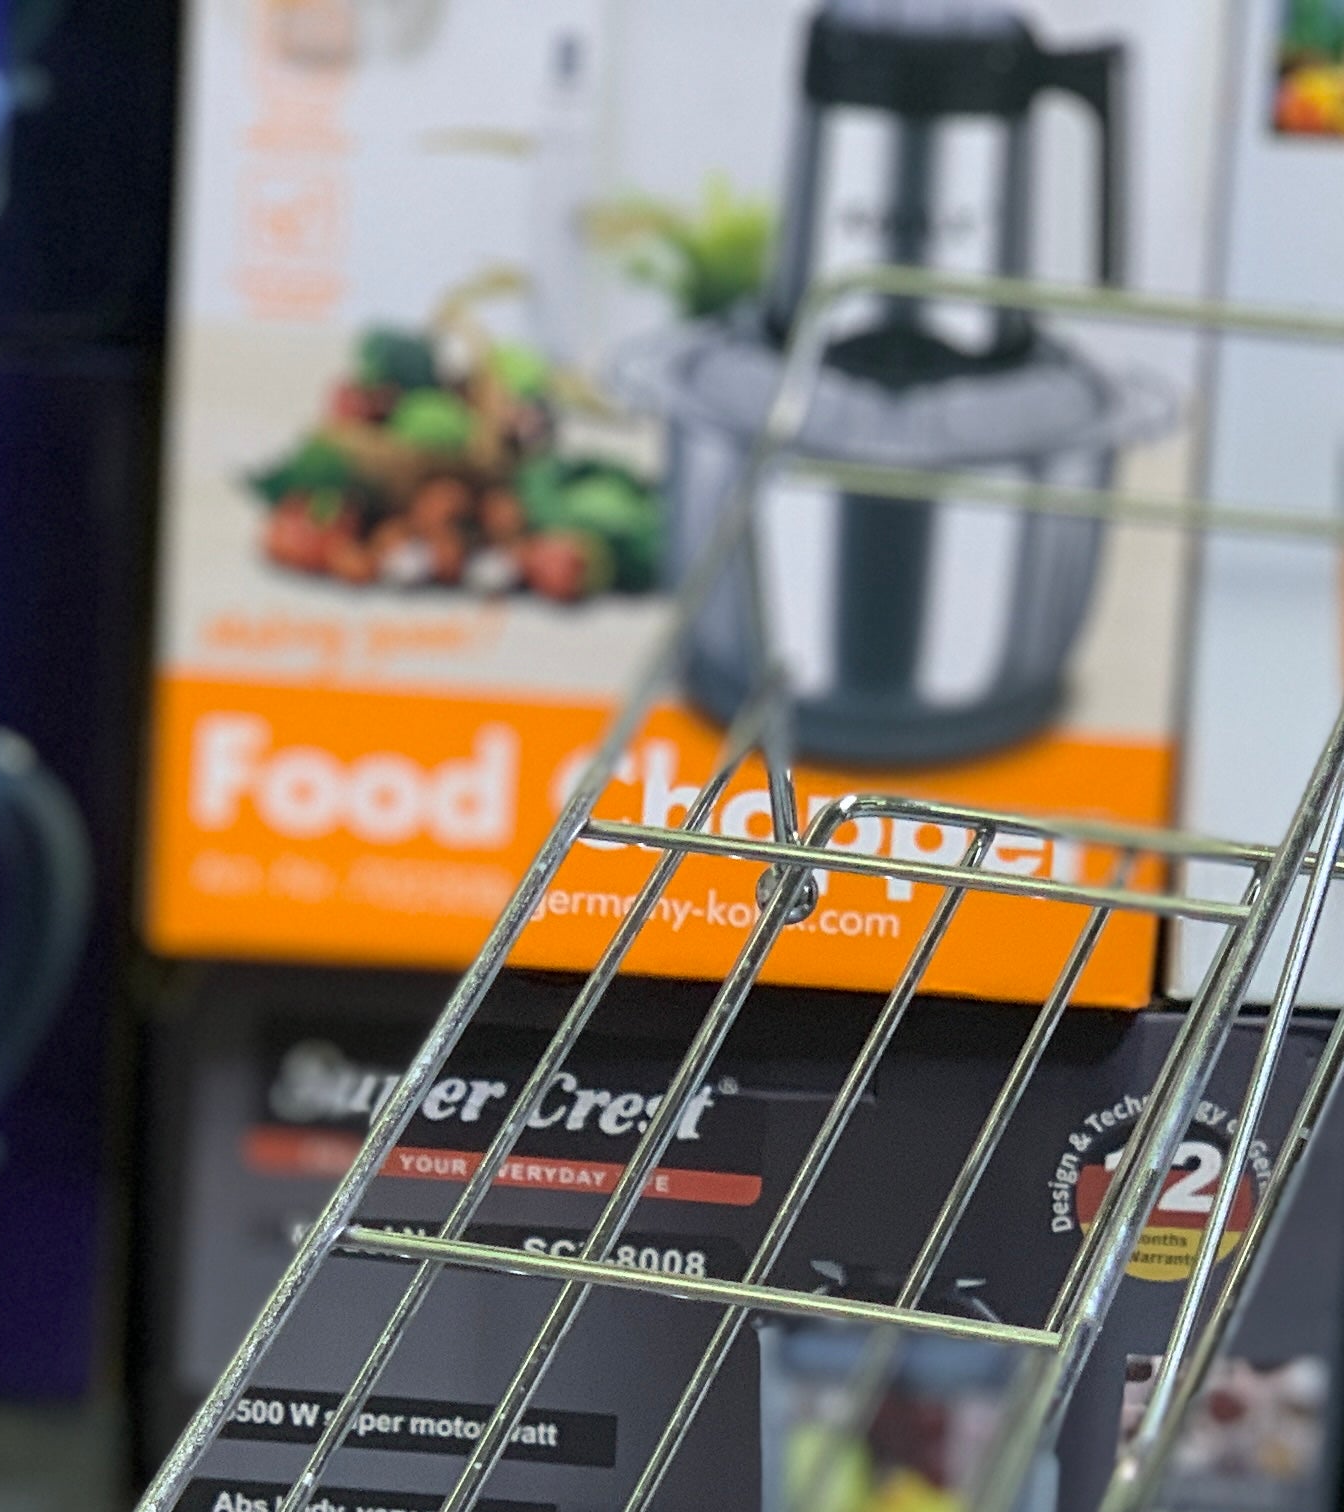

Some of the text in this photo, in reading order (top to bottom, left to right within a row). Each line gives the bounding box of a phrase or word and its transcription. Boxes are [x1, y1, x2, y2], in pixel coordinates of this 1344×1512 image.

[192, 712, 518, 848] Food
[1084, 1092, 1228, 1135] Techgy
[398, 1153, 467, 1177] YOUR
[496, 1162, 606, 1187] VERYDAY
[522, 1237, 707, 1280] SC-8008
[227, 1398, 285, 1426] 500
[289, 1402, 321, 1428] W
[324, 1408, 406, 1437] sper
[409, 1414, 488, 1439] moto
